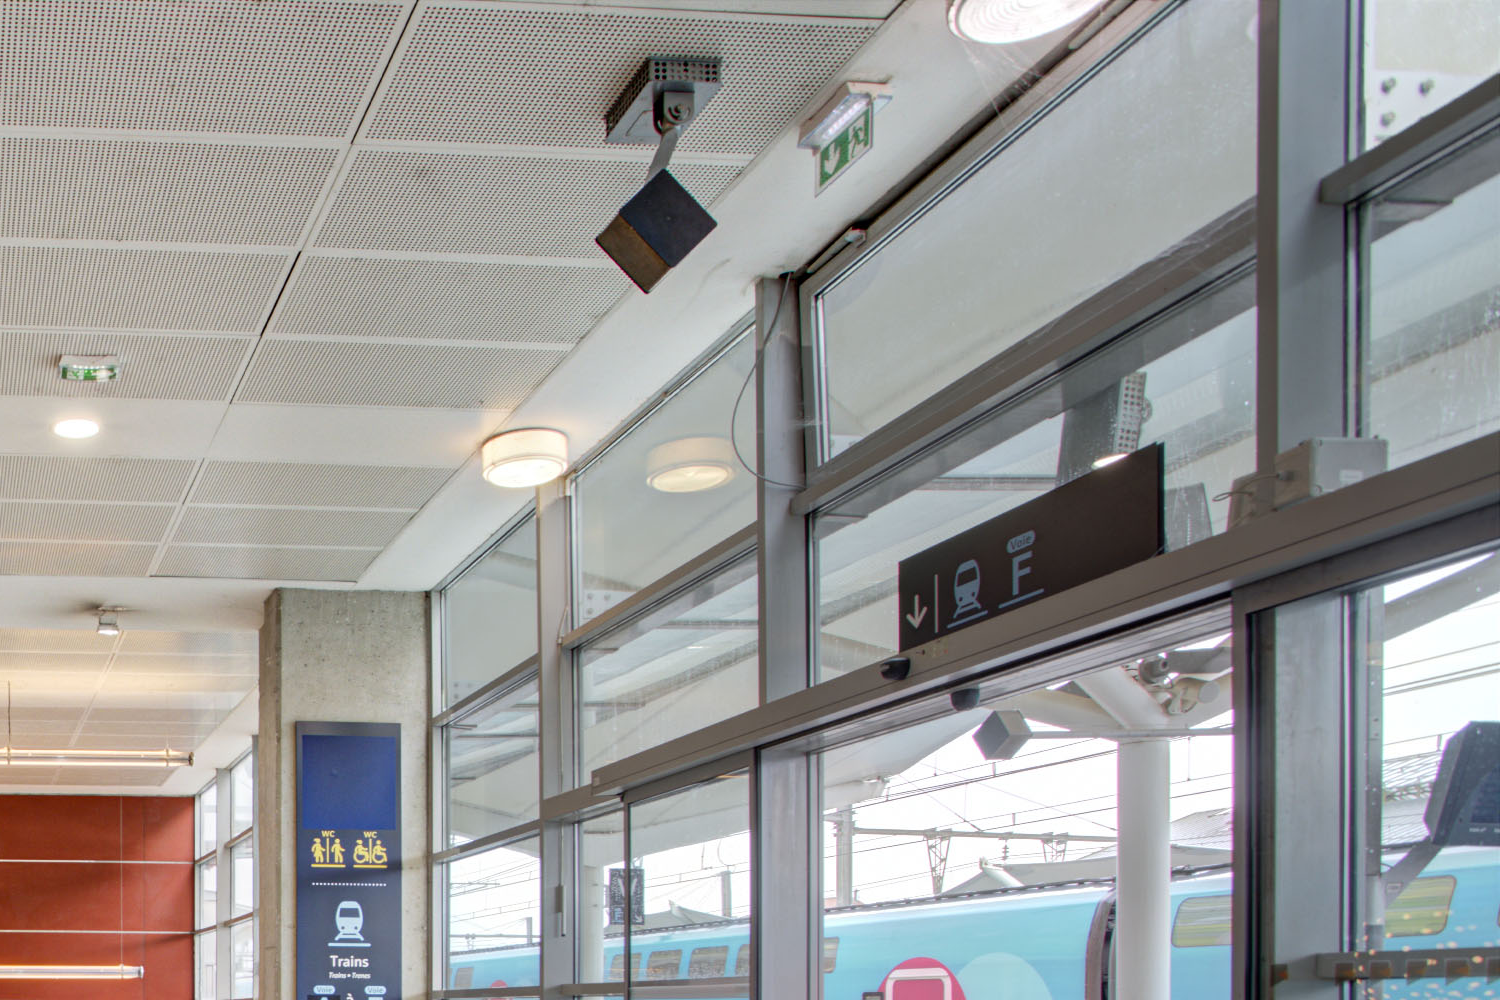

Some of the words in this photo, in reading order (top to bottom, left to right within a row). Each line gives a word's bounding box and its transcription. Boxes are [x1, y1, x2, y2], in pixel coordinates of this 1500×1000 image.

[1009, 535, 1032, 551] Voie
[1012, 551, 1033, 595] F
[329, 955, 370, 968] Trains
